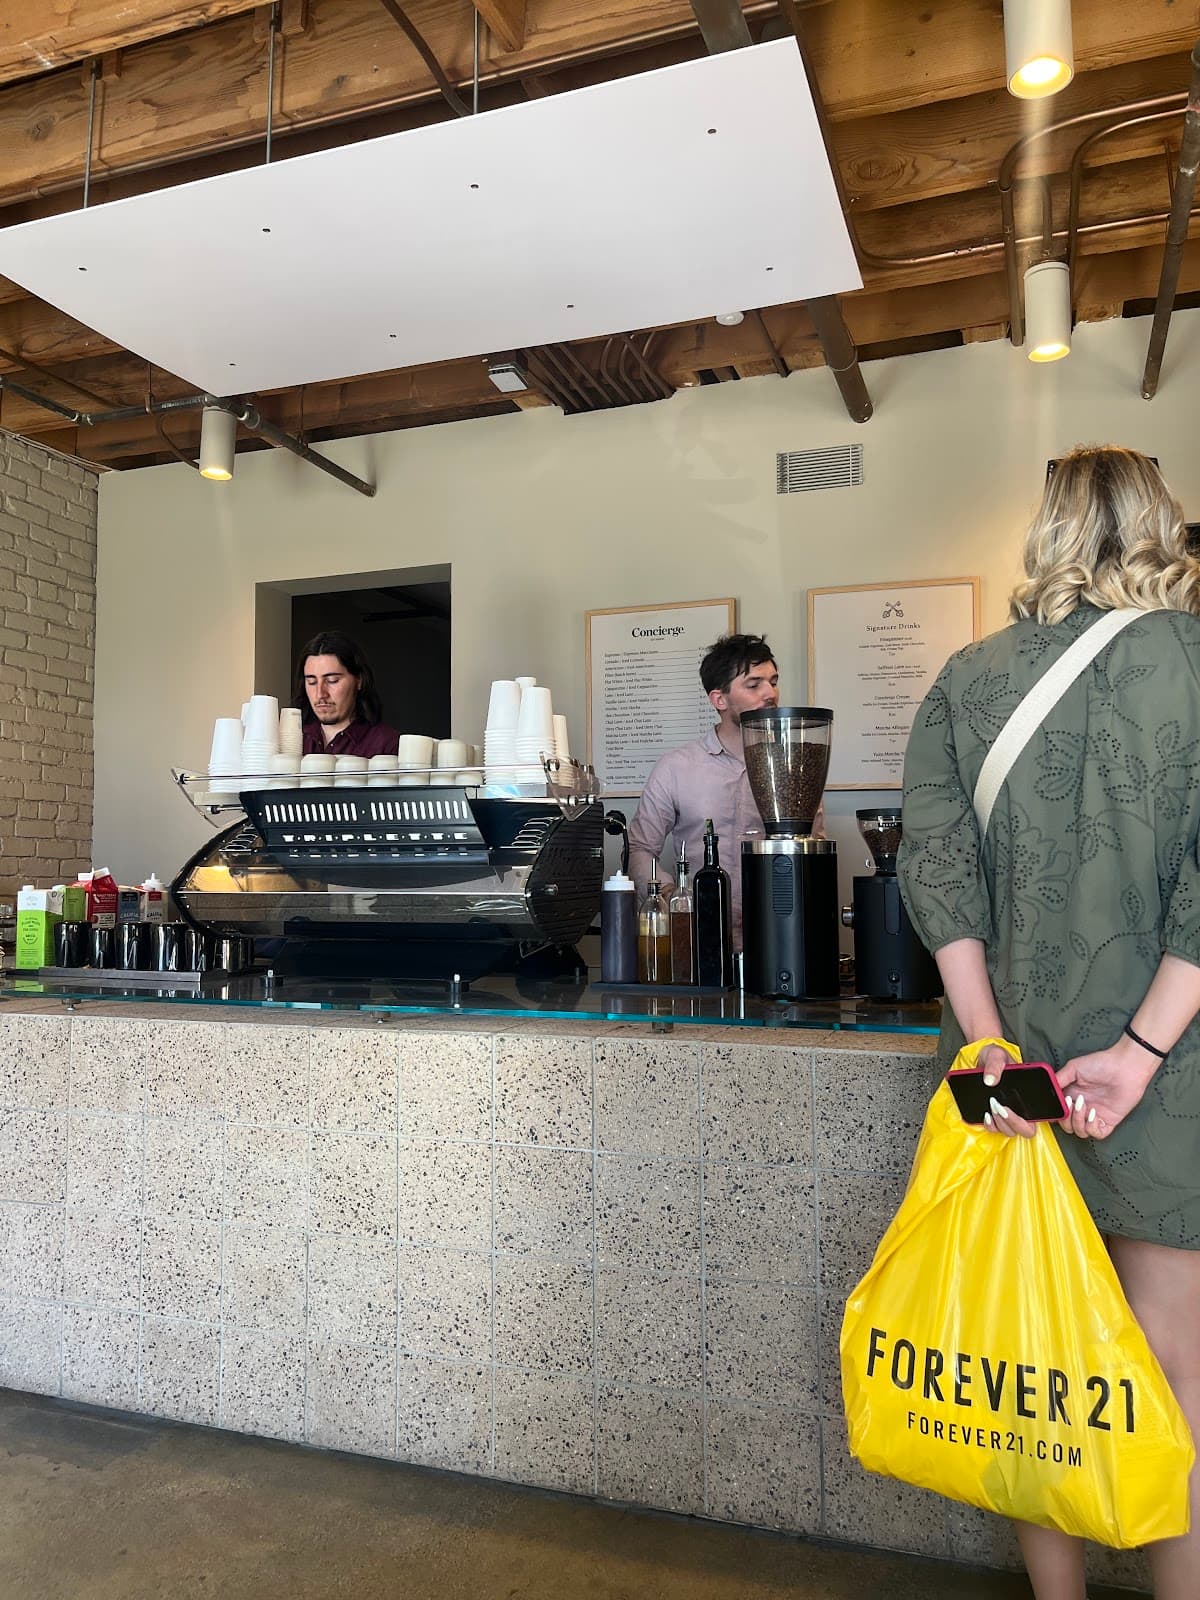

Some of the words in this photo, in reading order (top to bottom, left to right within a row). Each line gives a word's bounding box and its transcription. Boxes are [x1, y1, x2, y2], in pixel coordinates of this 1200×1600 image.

[631, 626, 685, 638] Concierge
[866, 1327, 1072, 1426] FOREVER
[1086, 1376, 1135, 1432] 21
[908, 1412, 1082, 1466] FOREVER21.COM
